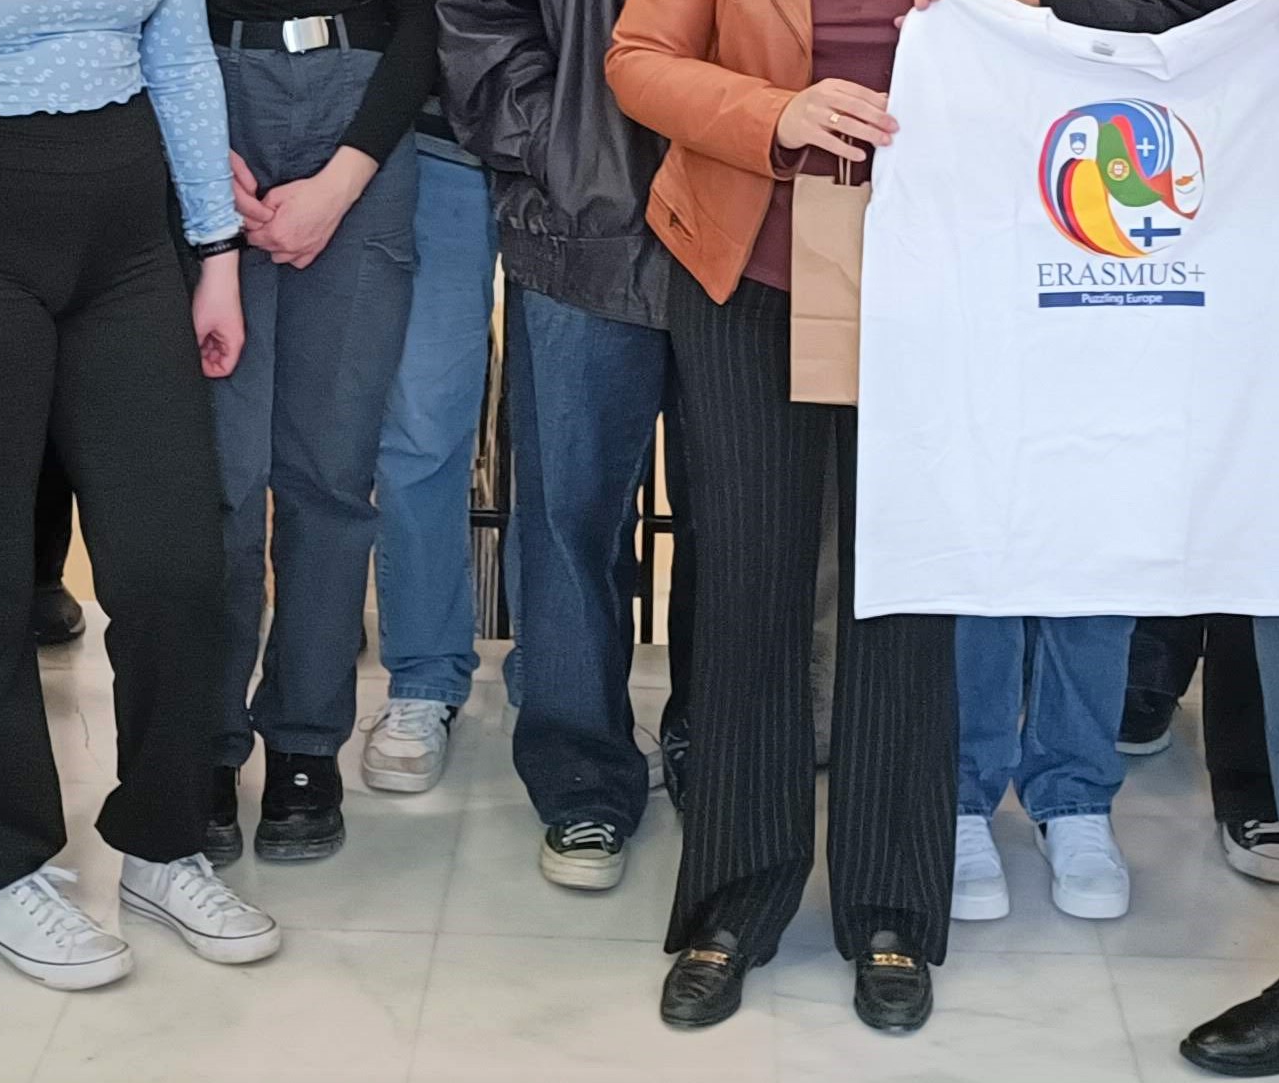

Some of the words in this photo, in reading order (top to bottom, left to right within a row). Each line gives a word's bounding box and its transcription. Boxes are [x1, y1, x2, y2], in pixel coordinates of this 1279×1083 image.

[1037, 262, 1206, 287] ERASMUS+
[1081, 293, 1124, 305] Puzzling
[1126, 293, 1163, 305] Europe
